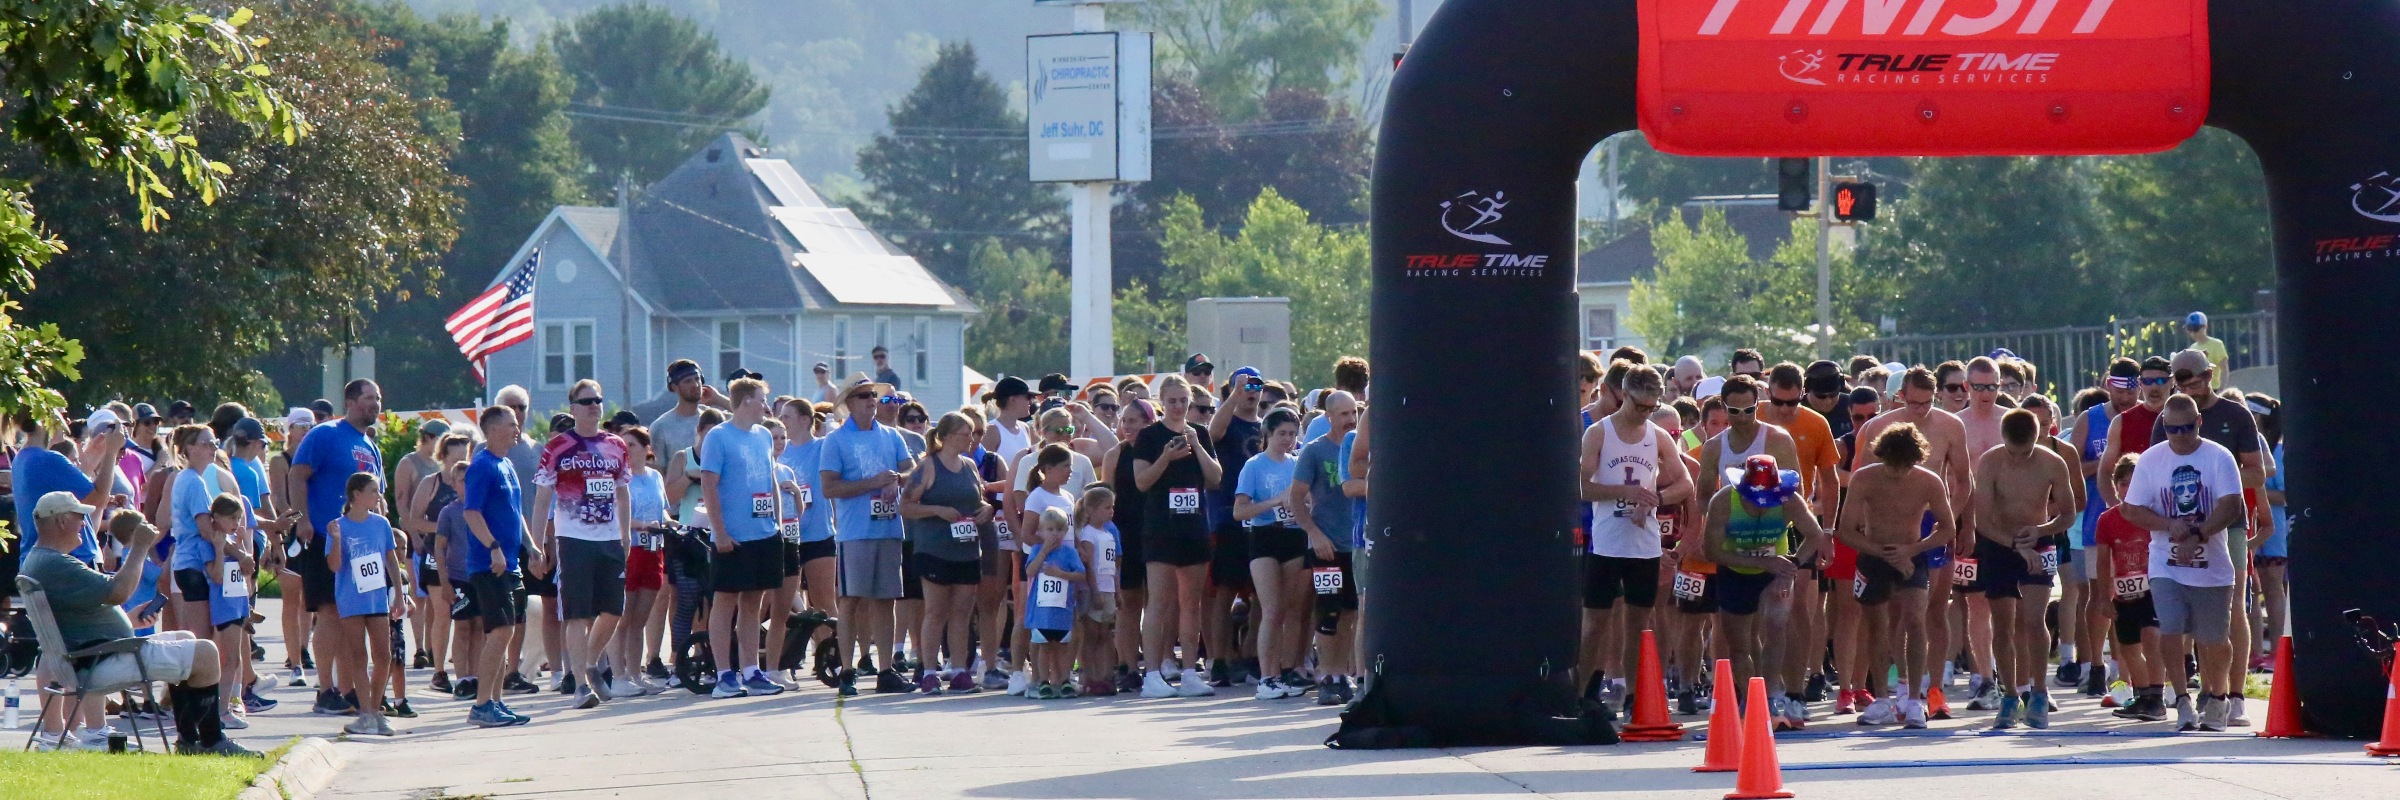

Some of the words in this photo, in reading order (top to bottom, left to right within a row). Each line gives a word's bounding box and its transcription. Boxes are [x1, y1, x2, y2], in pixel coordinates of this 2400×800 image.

[1837, 53, 1952, 72] TRUE
[1957, 52, 2060, 71] TIME
[1051, 66, 1110, 80] CHIROPRACTIC
[1837, 74, 1920, 84] RACING
[1938, 73, 2047, 84] SERVICES
[1040, 122, 1058, 138] Jeff
[1060, 121, 1087, 139] Suhr,
[1089, 120, 1104, 136] DC
[2315, 234, 2395, 255] TRUE
[1406, 253, 1481, 268] TRUE
[1484, 253, 1549, 268] TIME
[2316, 251, 2372, 263] RACING
[1406, 268, 1459, 277] RACING
[1471, 268, 1543, 277] SERVICES
[1607, 455, 1629, 469] LORAS
[1629, 456, 1653, 472] COLLEGE
[1624, 466, 1640, 485] L
[589, 481, 614, 492] 1052
[755, 499, 772, 511] 884
[873, 501, 896, 513] 805
[1174, 494, 1197, 507] 918
[953, 524, 977, 535] 1004
[360, 561, 379, 577] 603
[1043, 580, 1062, 594] 630
[1315, 574, 1341, 587] 956
[1675, 575, 1705, 594] 958
[2117, 577, 2144, 594] 987
